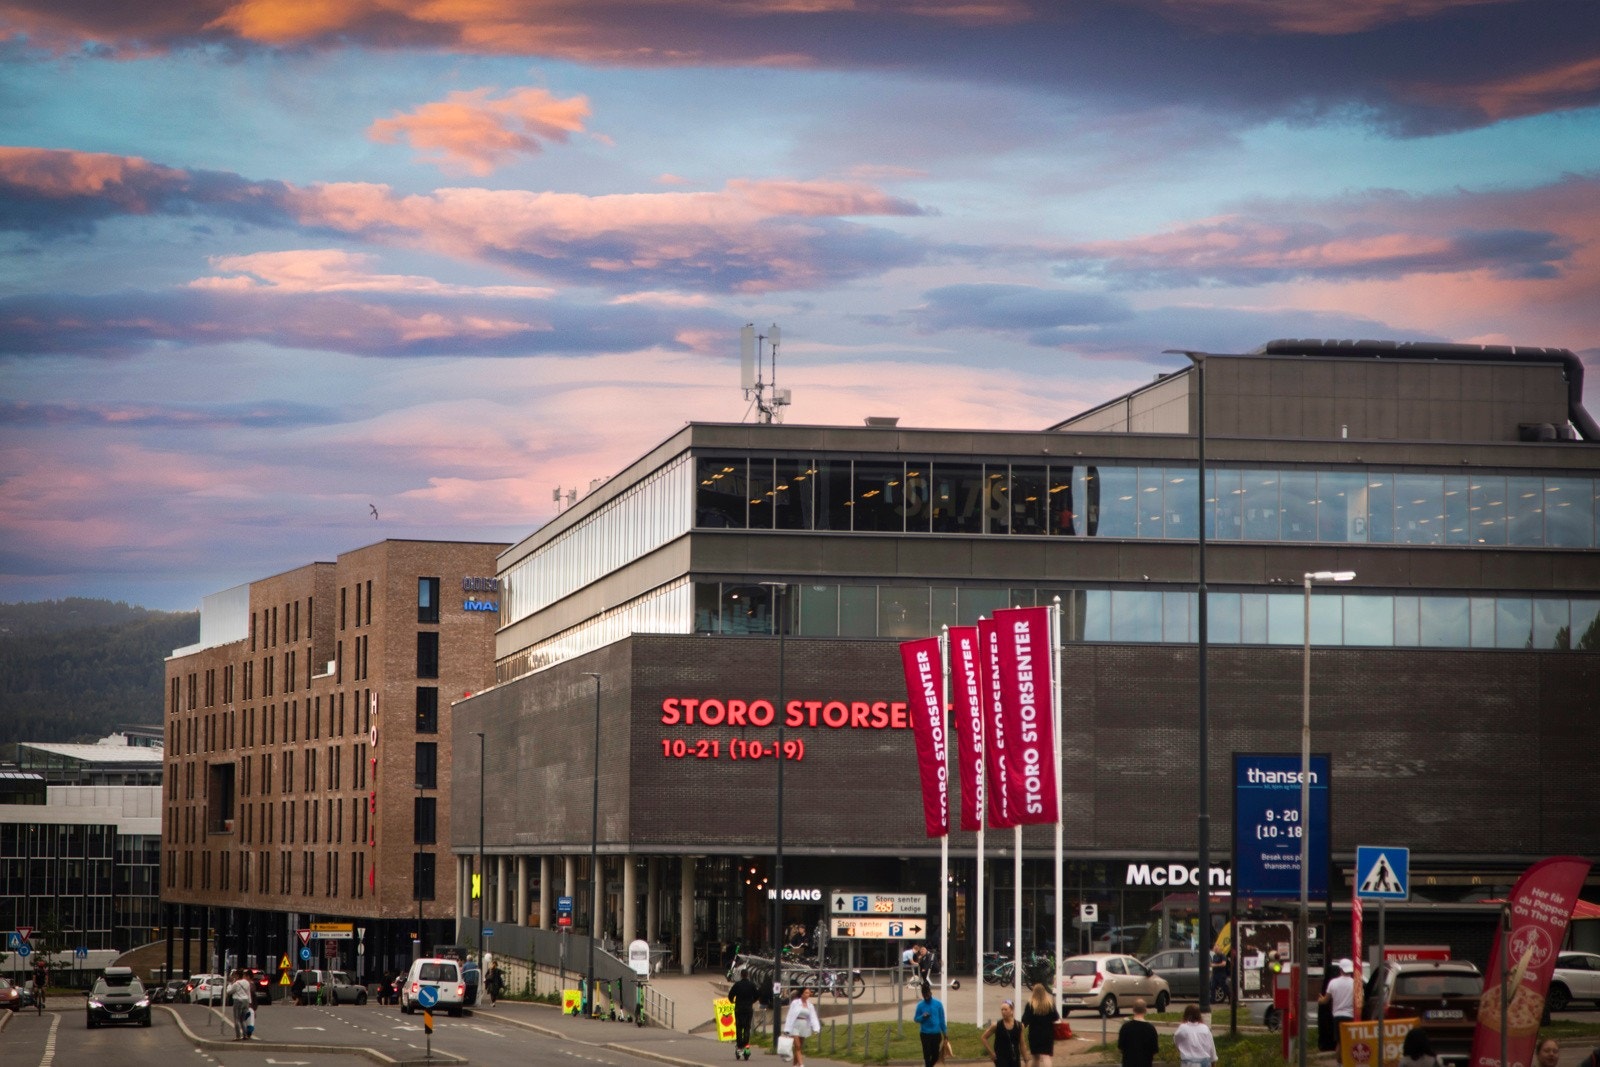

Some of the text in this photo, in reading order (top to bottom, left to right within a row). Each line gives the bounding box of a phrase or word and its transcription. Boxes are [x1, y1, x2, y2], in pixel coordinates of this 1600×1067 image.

[916, 650, 945, 760] STORSENTER
[961, 638, 982, 752] STORSENTER
[661, 698, 914, 728] STORO STORSE
[1014, 620, 1043, 814] STORO STORSENTER
[661, 738, 804, 761] 10-21 (10-19)
[1247, 768, 1318, 784] thansen
[875, 895, 894, 903] Storo
[1519, 896, 1569, 916] du Peppes
[1532, 888, 1565, 903] Her får
[900, 905, 921, 913] Ledige
[1514, 905, 1568, 928] On The Go!
[860, 920, 882, 928] senter
